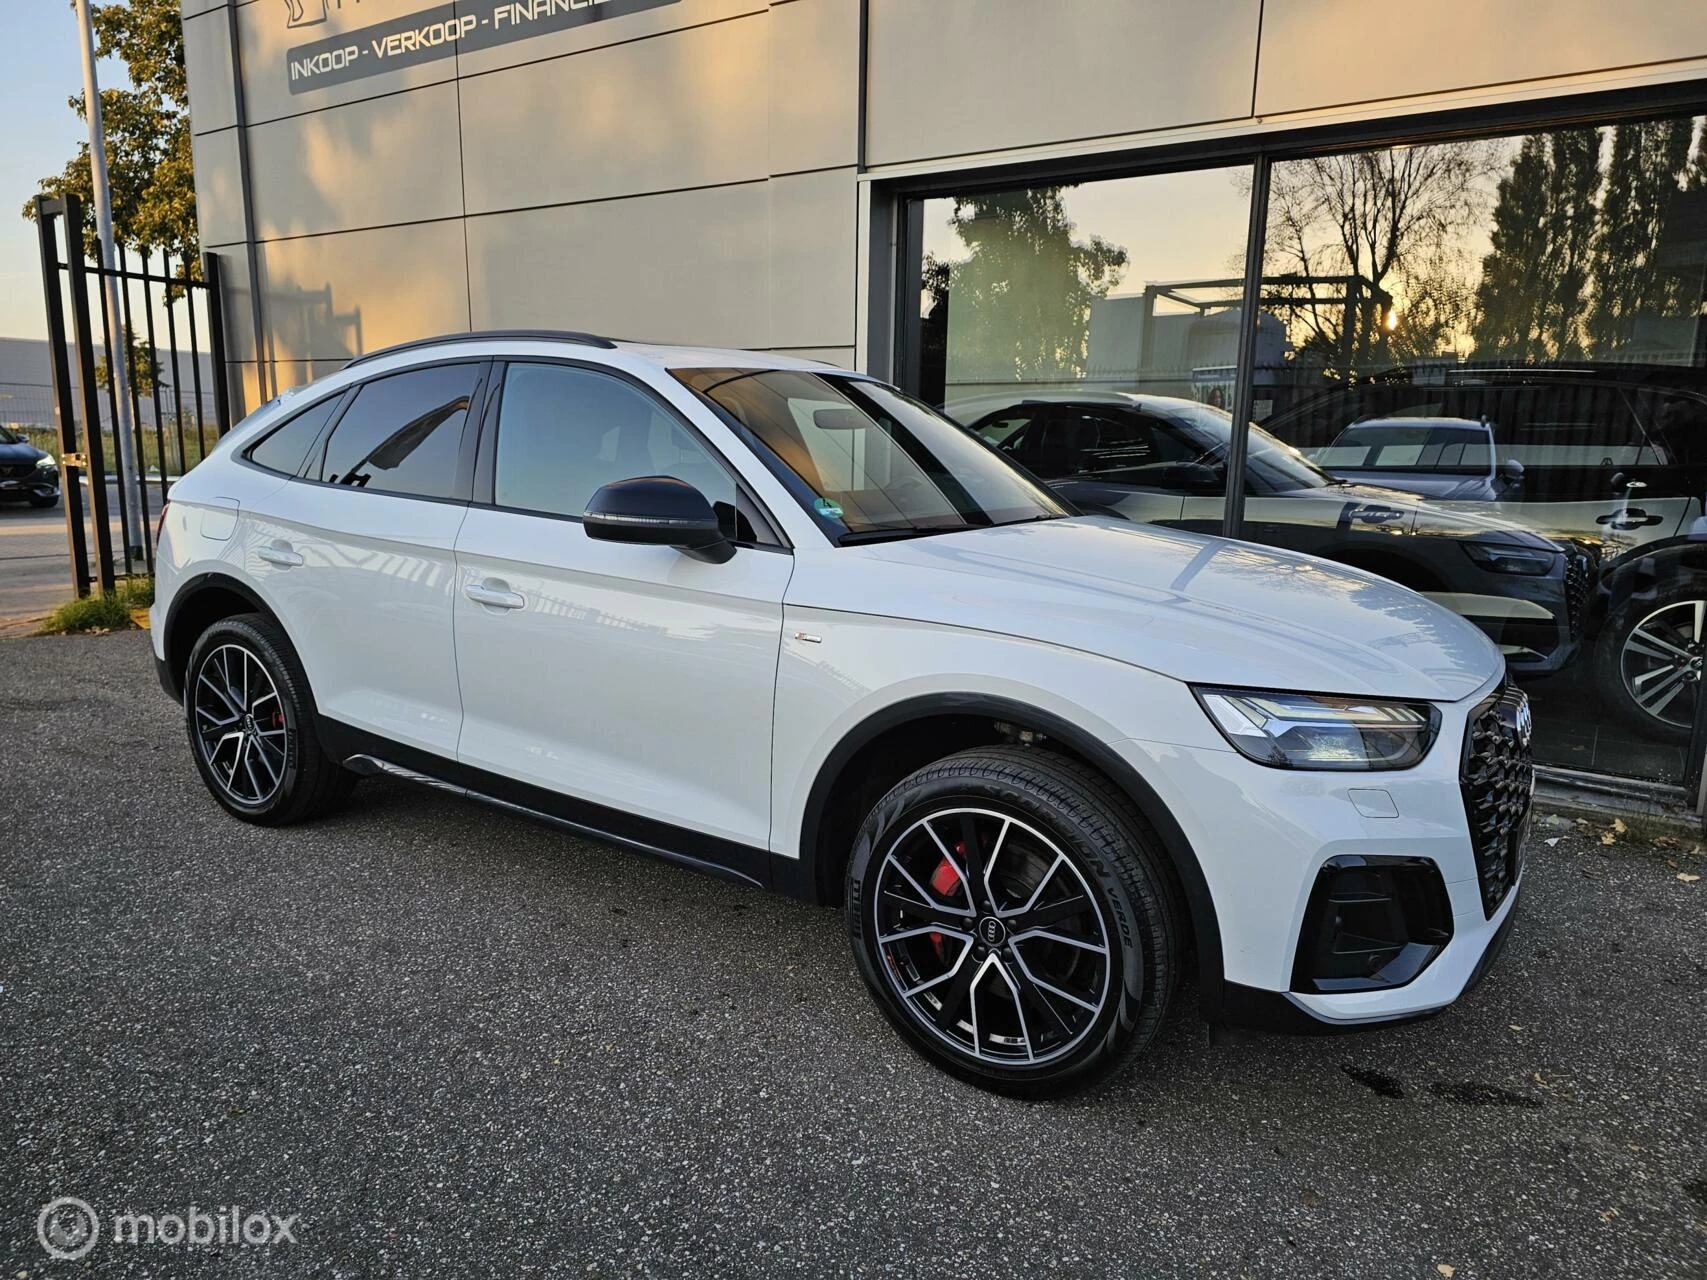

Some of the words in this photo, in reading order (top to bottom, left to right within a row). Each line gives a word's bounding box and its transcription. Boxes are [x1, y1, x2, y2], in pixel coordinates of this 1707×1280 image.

[290, 45, 359, 81] INKOOP
[371, 14, 477, 59] VERKOOP
[1107, 887, 1133, 949] VERDE
